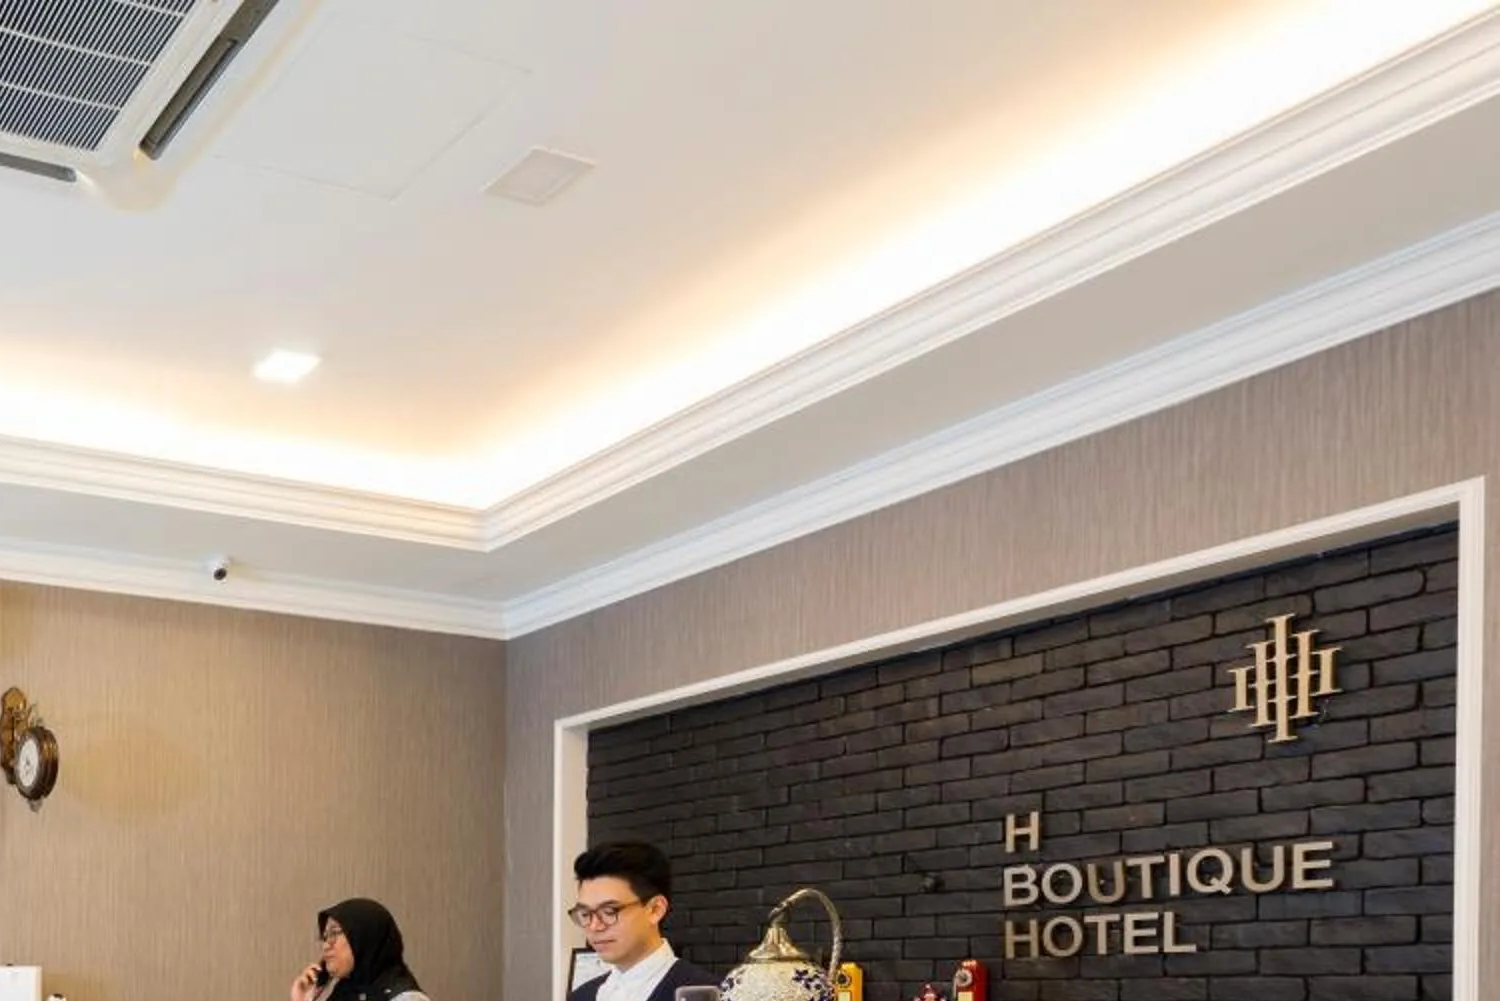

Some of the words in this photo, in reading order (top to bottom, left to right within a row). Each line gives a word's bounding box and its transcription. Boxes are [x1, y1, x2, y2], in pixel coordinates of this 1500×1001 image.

[1004, 811, 1040, 853] H
[1003, 841, 1335, 906] BOUTIQUE
[1004, 911, 1197, 960] HOTEL
